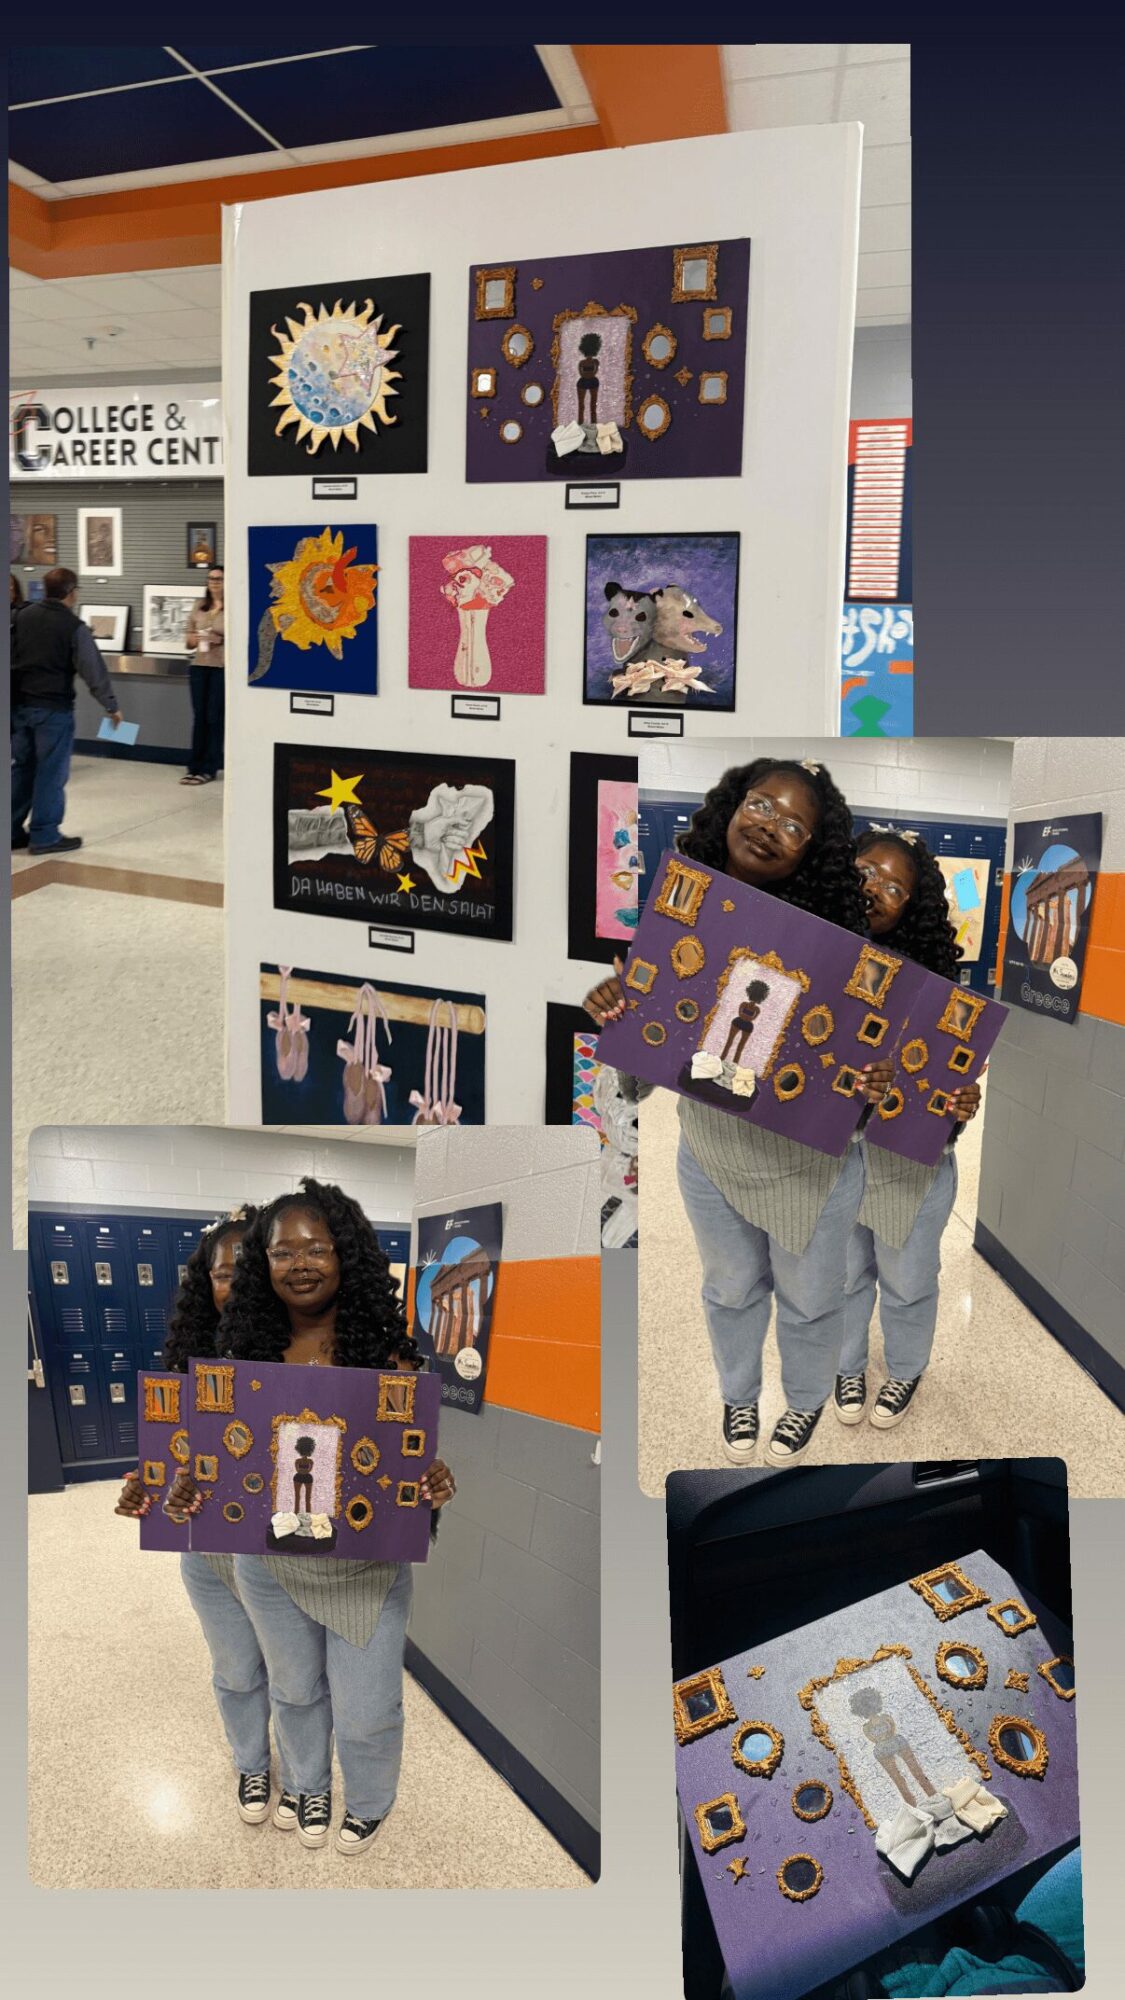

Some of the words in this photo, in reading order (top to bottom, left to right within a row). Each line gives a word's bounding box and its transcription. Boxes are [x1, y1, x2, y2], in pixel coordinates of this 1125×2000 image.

[165, 403, 187, 431] &
[148, 436, 224, 466] CENT
[291, 876, 311, 897] DA
[316, 879, 366, 900] HABEN
[369, 891, 401, 908] WIR
[410, 893, 444, 912] DEN
[449, 900, 495, 919] SALAT
[1021, 982, 1070, 1015] Greece
[440, 1383, 475, 1404] eece
